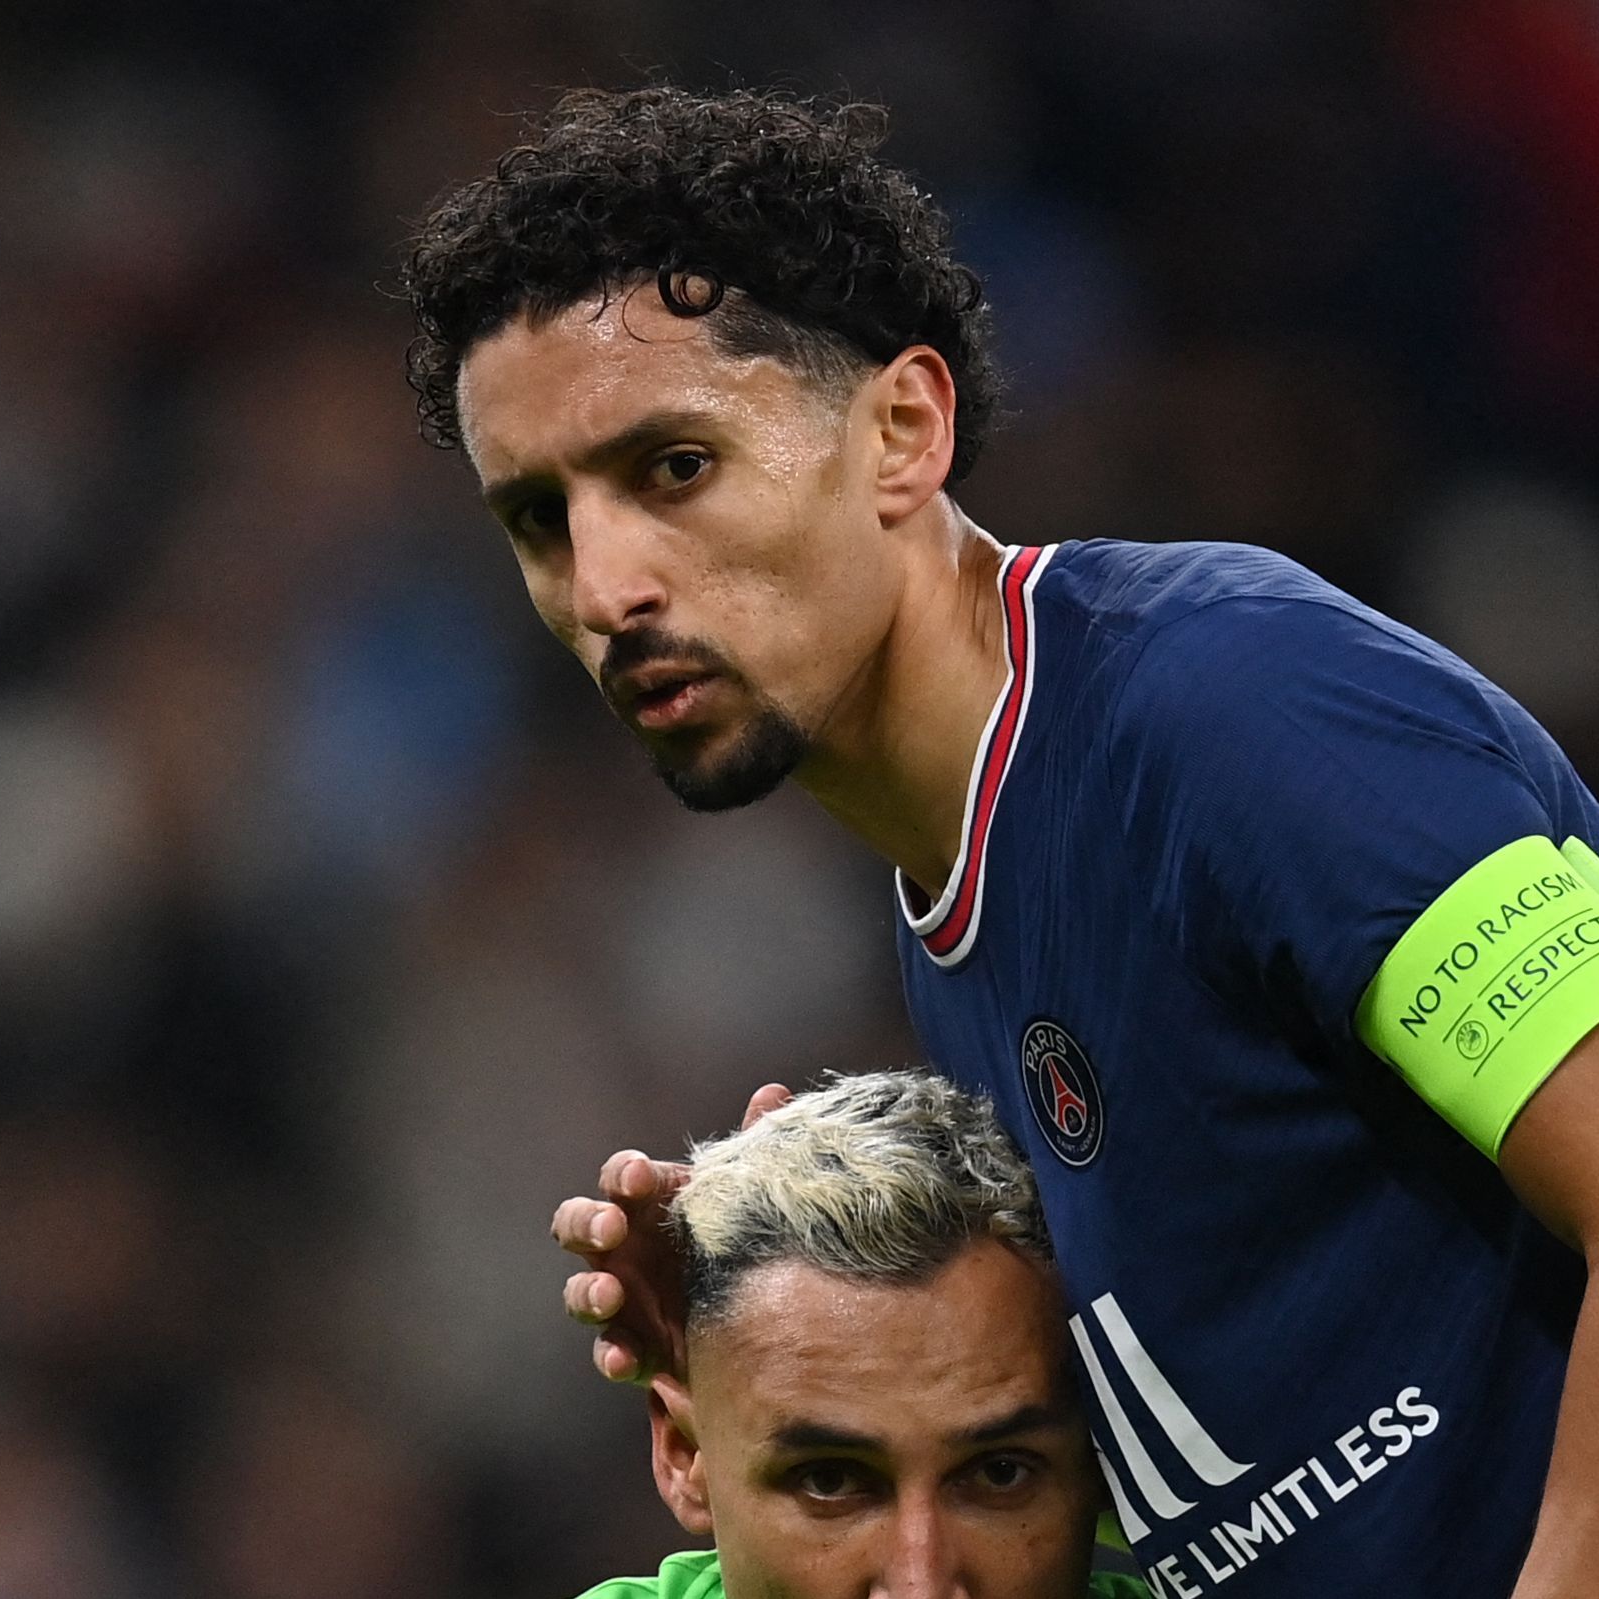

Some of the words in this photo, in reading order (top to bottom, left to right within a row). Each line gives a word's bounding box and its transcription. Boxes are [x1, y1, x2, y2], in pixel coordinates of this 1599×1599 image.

[1399, 984, 1441, 1038] NO
[1434, 941, 1479, 985] TO
[1476, 871, 1585, 945] RACISM
[1026, 1029, 1067, 1072] PARIS
[1186, 1386, 1441, 1585] LIMITLESS
